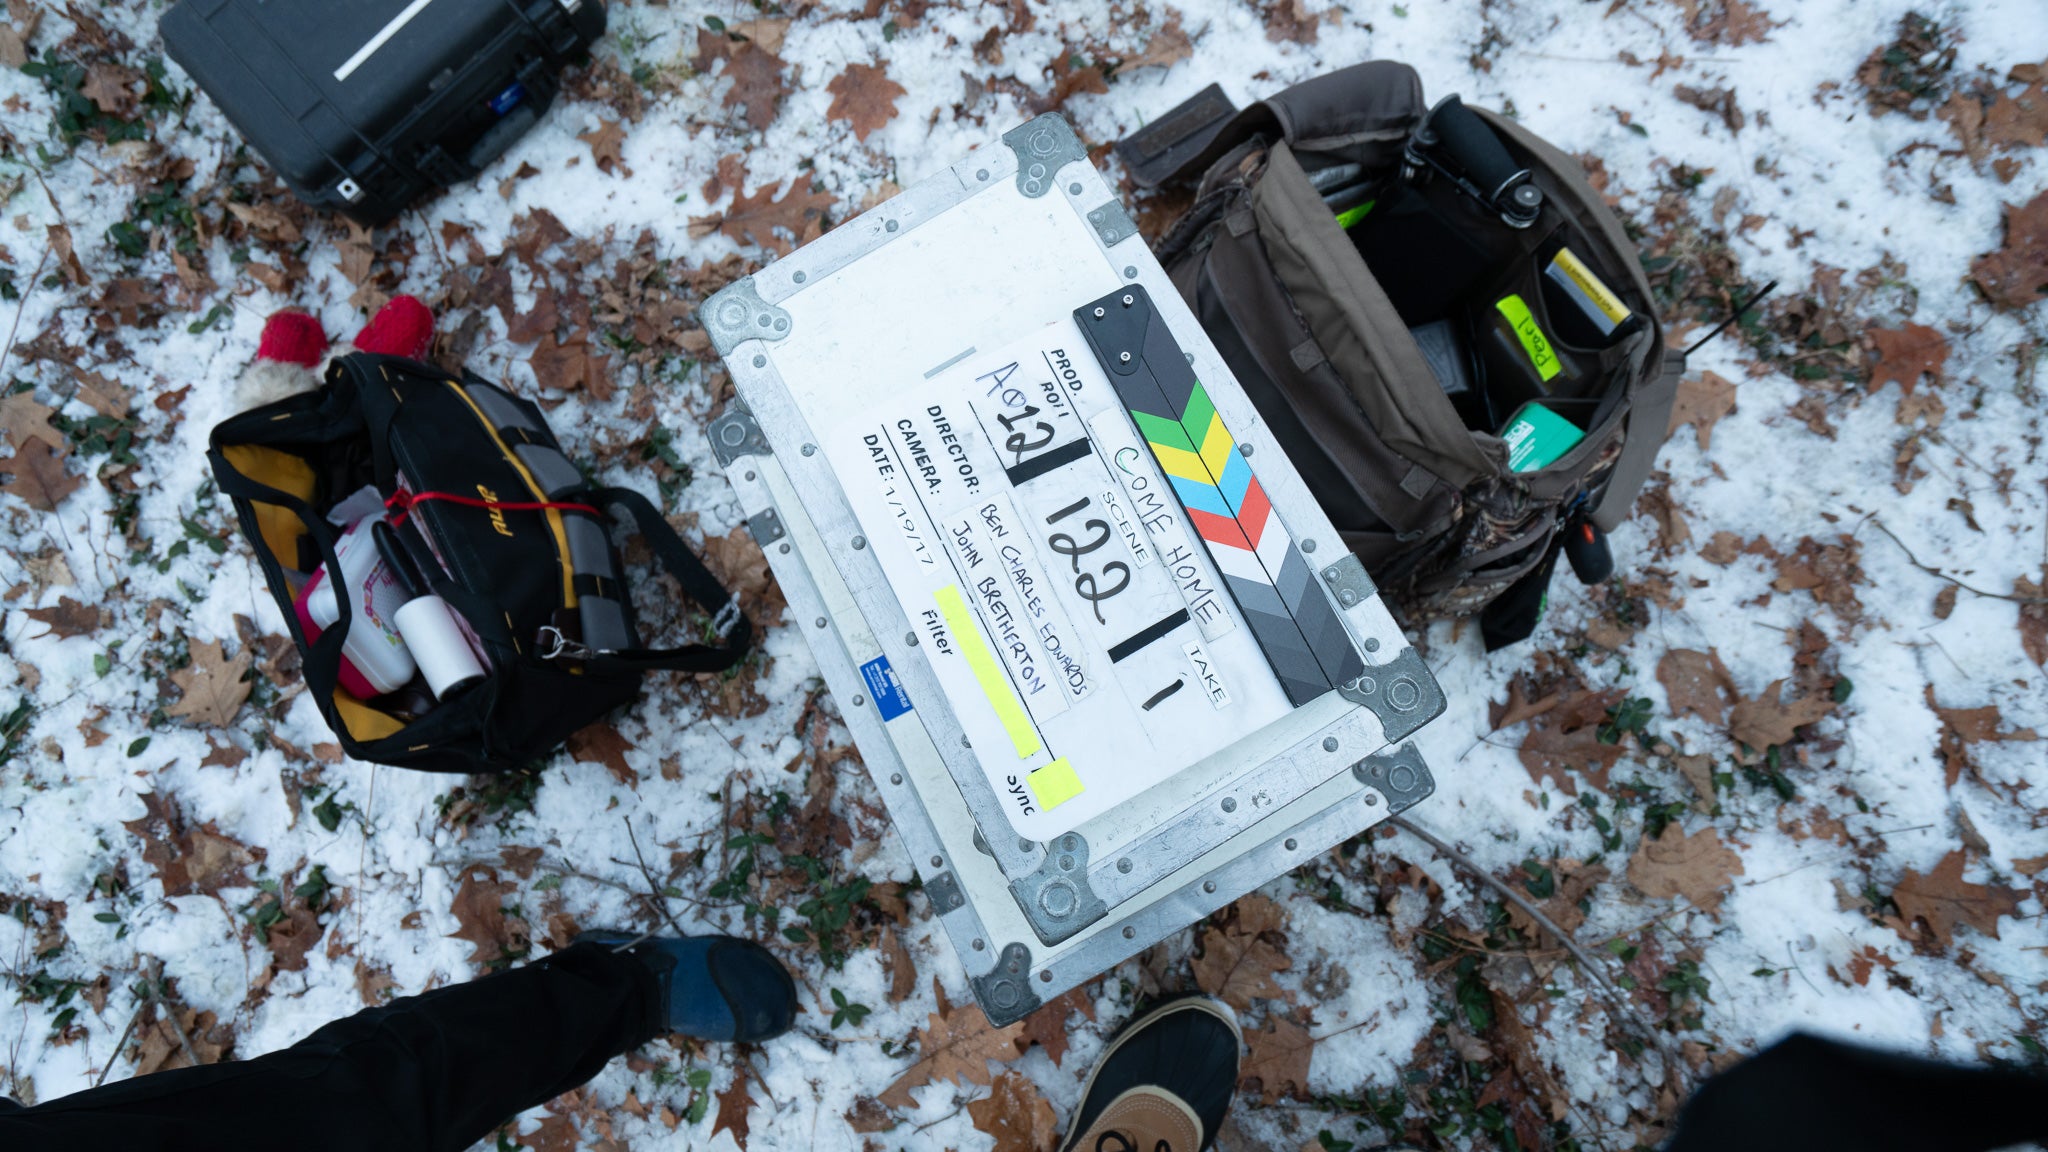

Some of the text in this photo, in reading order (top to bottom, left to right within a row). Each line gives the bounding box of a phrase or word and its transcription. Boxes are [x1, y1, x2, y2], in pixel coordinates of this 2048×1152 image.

[1050, 348, 1083, 397] PROD.
[1518, 316, 1552, 367] Pearl
[862, 433, 895, 480] DATE:
[897, 418, 942, 495] CAMERA:
[926, 404, 980, 495] DIRECTOR:
[885, 486, 934, 564] 1/19/17
[1045, 496, 1131, 626] 122
[1102, 491, 1149, 563] SCENE
[1114, 446, 1222, 626] COME HOME
[921, 609, 954, 655] Filter
[979, 503, 1088, 696] BEN CHARLES EDWARDS
[971, 576, 1047, 696] BRETHERTON
[894, 685, 911, 709] Rental
[1141, 678, 1185, 712] 1
[1190, 645, 1227, 703] TAKE
